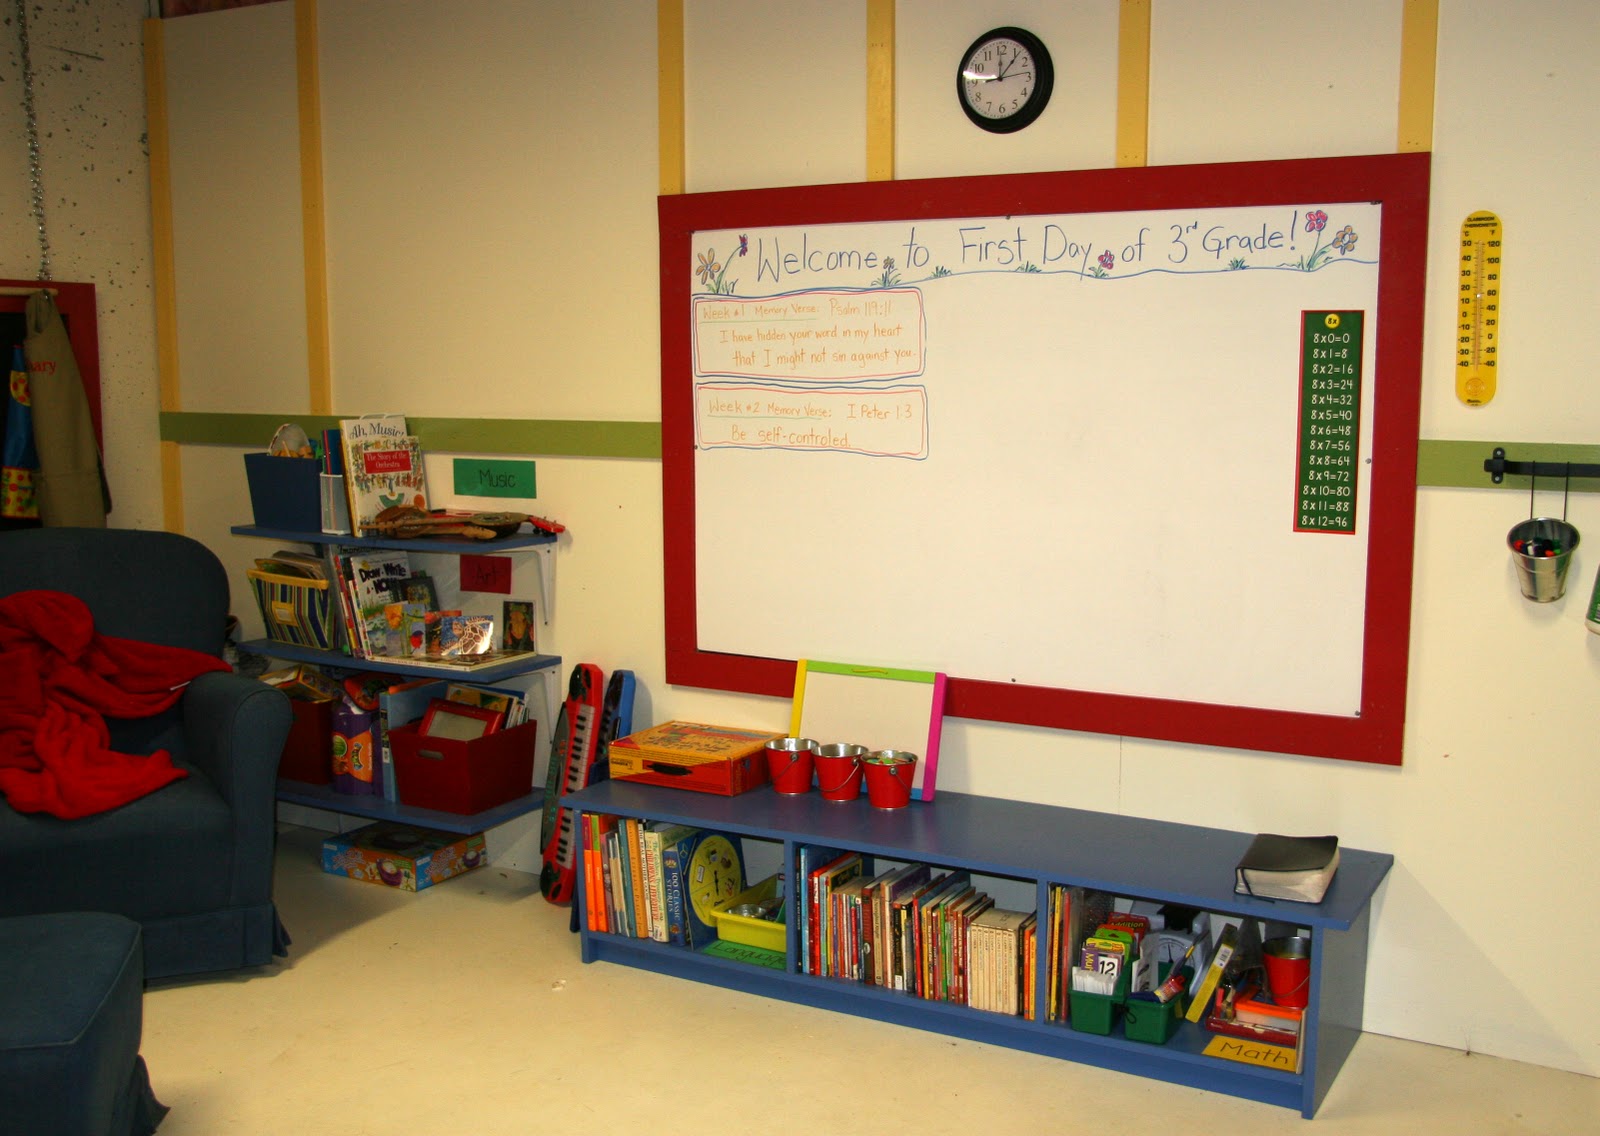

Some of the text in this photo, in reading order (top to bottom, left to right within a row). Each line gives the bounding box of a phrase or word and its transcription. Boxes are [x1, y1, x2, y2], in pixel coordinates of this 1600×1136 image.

[996, 45, 1007, 55] 12
[984, 51, 992, 61] 11
[1022, 57, 1028, 67] 2
[974, 64, 984, 73] 10
[1025, 72, 1031, 82] 3
[971, 79, 978, 87] 9
[975, 92, 982, 102] 8
[1020, 88, 1028, 97] 4
[986, 102, 992, 111] 7
[999, 103, 1005, 113] 6
[1012, 99, 1018, 109] 5
[758, 233, 878, 282] Welcome
[903, 226, 930, 268] to
[959, 227, 1027, 263] First
[1043, 224, 1092, 280] Day
[1121, 228, 1150, 262] of
[1202, 210, 1297, 260] Grade!
[703, 304, 730, 320] Week
[755, 305, 787, 318] Memory
[829, 298, 860, 316] Psalm
[865, 300, 892, 317] 119:11
[720, 322, 902, 346] I have hidden your word in my heart
[732, 351, 756, 366] that
[764, 349, 771, 367] I
[777, 348, 806, 370] might
[811, 347, 827, 363] not
[832, 352, 846, 362] sin
[851, 348, 889, 368] against
[708, 396, 742, 413] Week
[768, 402, 800, 417] Memory
[804, 402, 832, 417] Verse:
[847, 403, 856, 418] I
[861, 403, 890, 419] Peter
[732, 424, 746, 441] Be
[377, 453, 391, 461] Story
[480, 468, 516, 488] Music
[673, 889, 681, 921] CLASSIC
[1100, 961, 1115, 974] 12
[1220, 1042, 1288, 1064] Math
